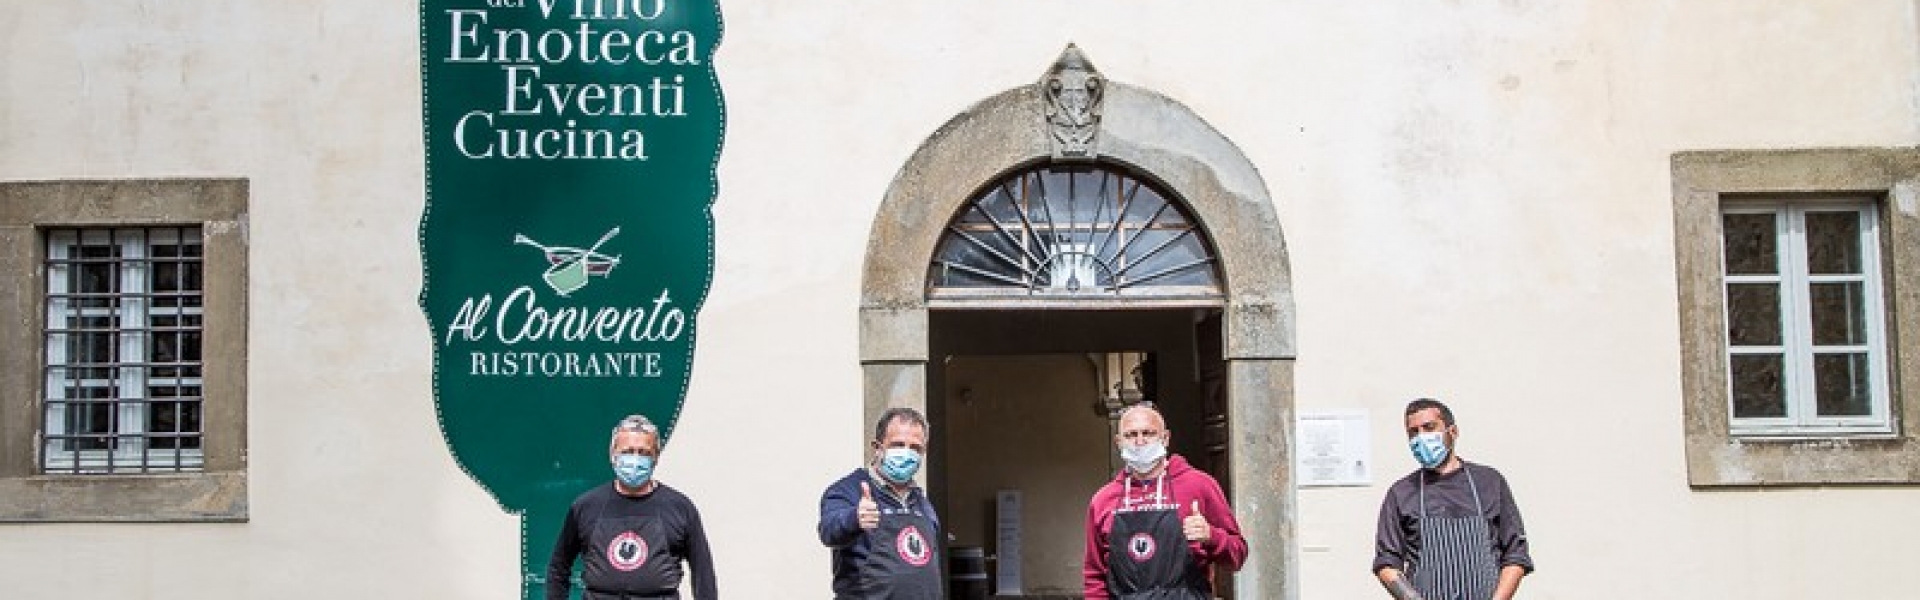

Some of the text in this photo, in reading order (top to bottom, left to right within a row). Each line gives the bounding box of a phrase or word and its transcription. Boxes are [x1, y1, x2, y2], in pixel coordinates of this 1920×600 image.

[444, 9, 701, 66] Enoteca
[499, 65, 688, 116] Eventi
[454, 110, 648, 160] Cucina
[445, 285, 685, 346] Al Convento
[470, 352, 662, 377] RISTORANTE
